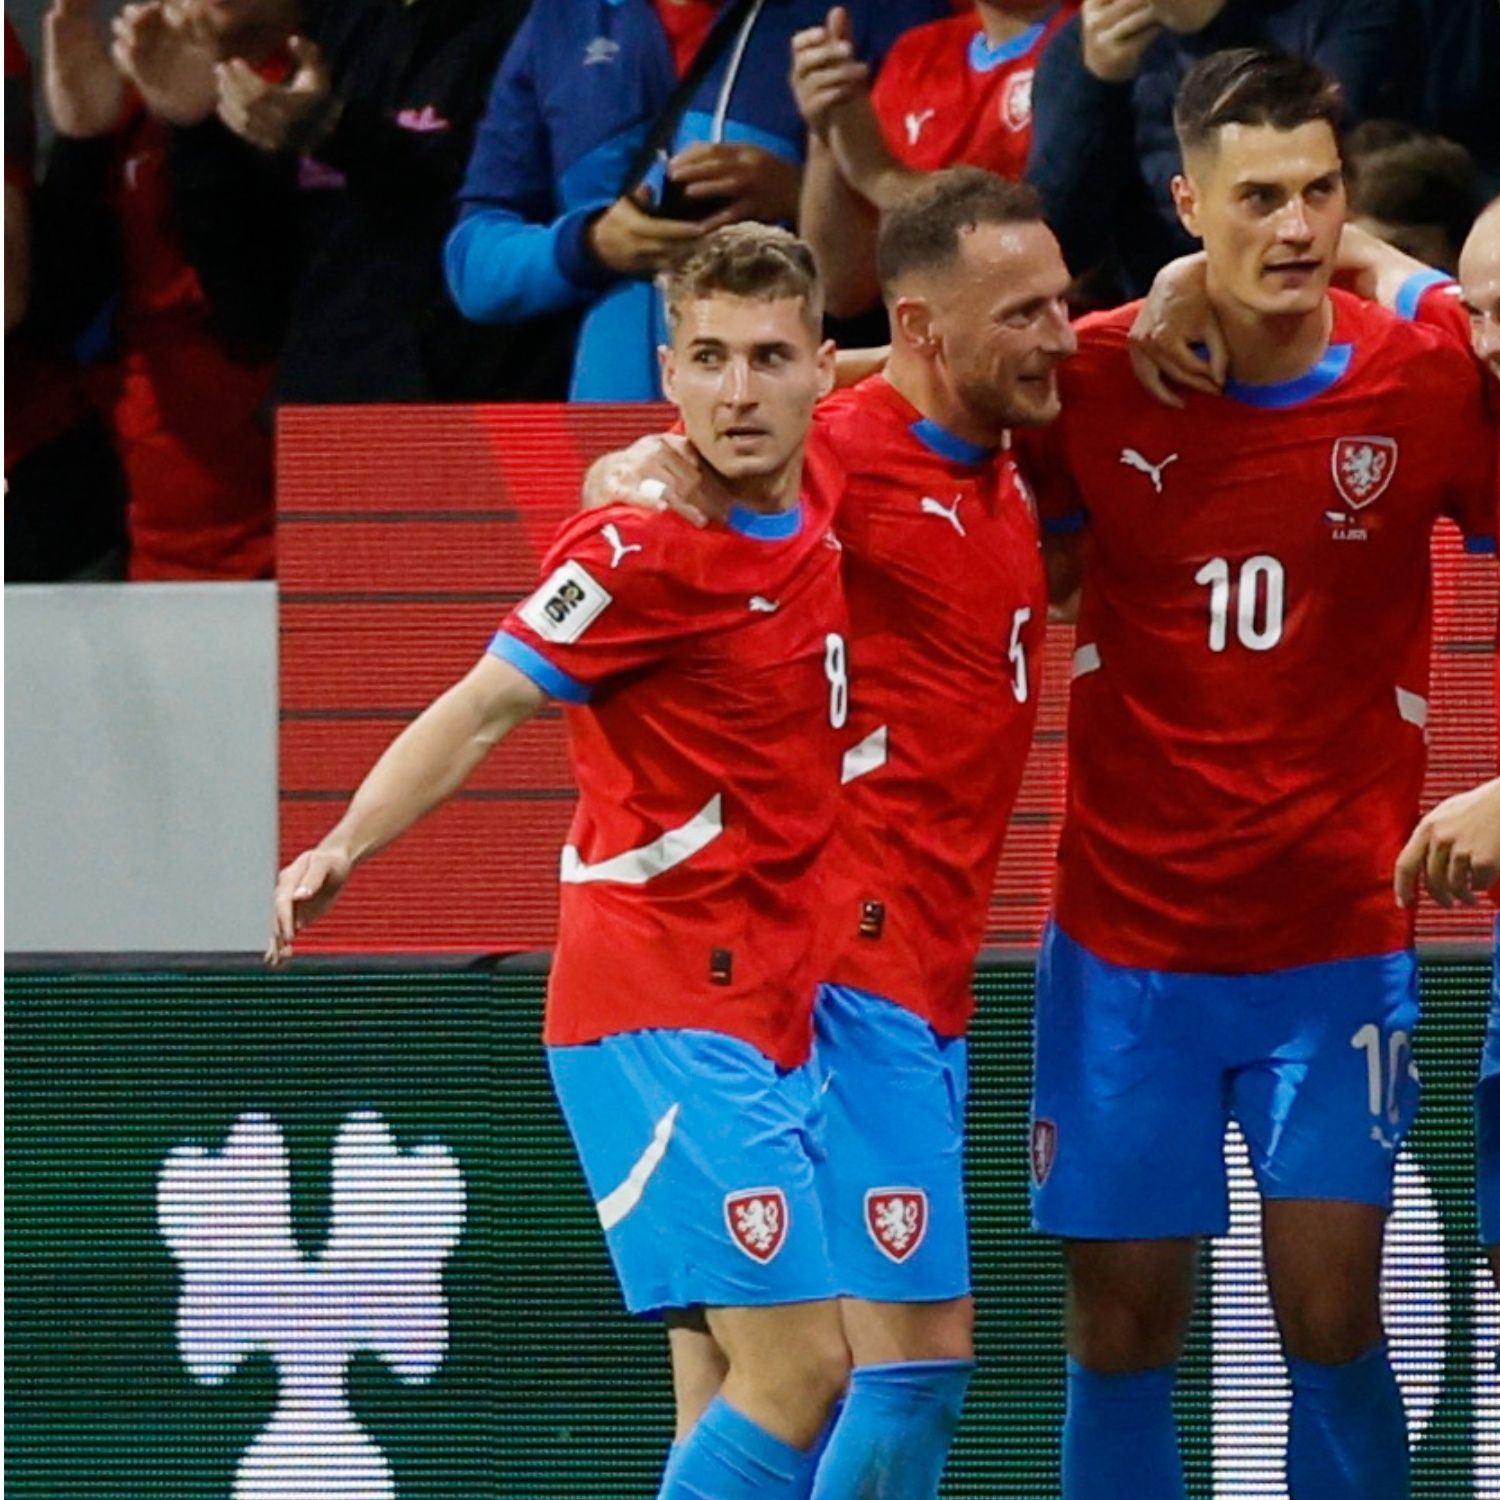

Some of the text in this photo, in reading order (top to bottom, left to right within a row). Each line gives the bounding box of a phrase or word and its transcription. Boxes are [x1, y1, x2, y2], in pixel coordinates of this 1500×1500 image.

[1194, 554, 1285, 652] 10
[823, 631, 849, 730] 8
[1008, 606, 1031, 703] 5
